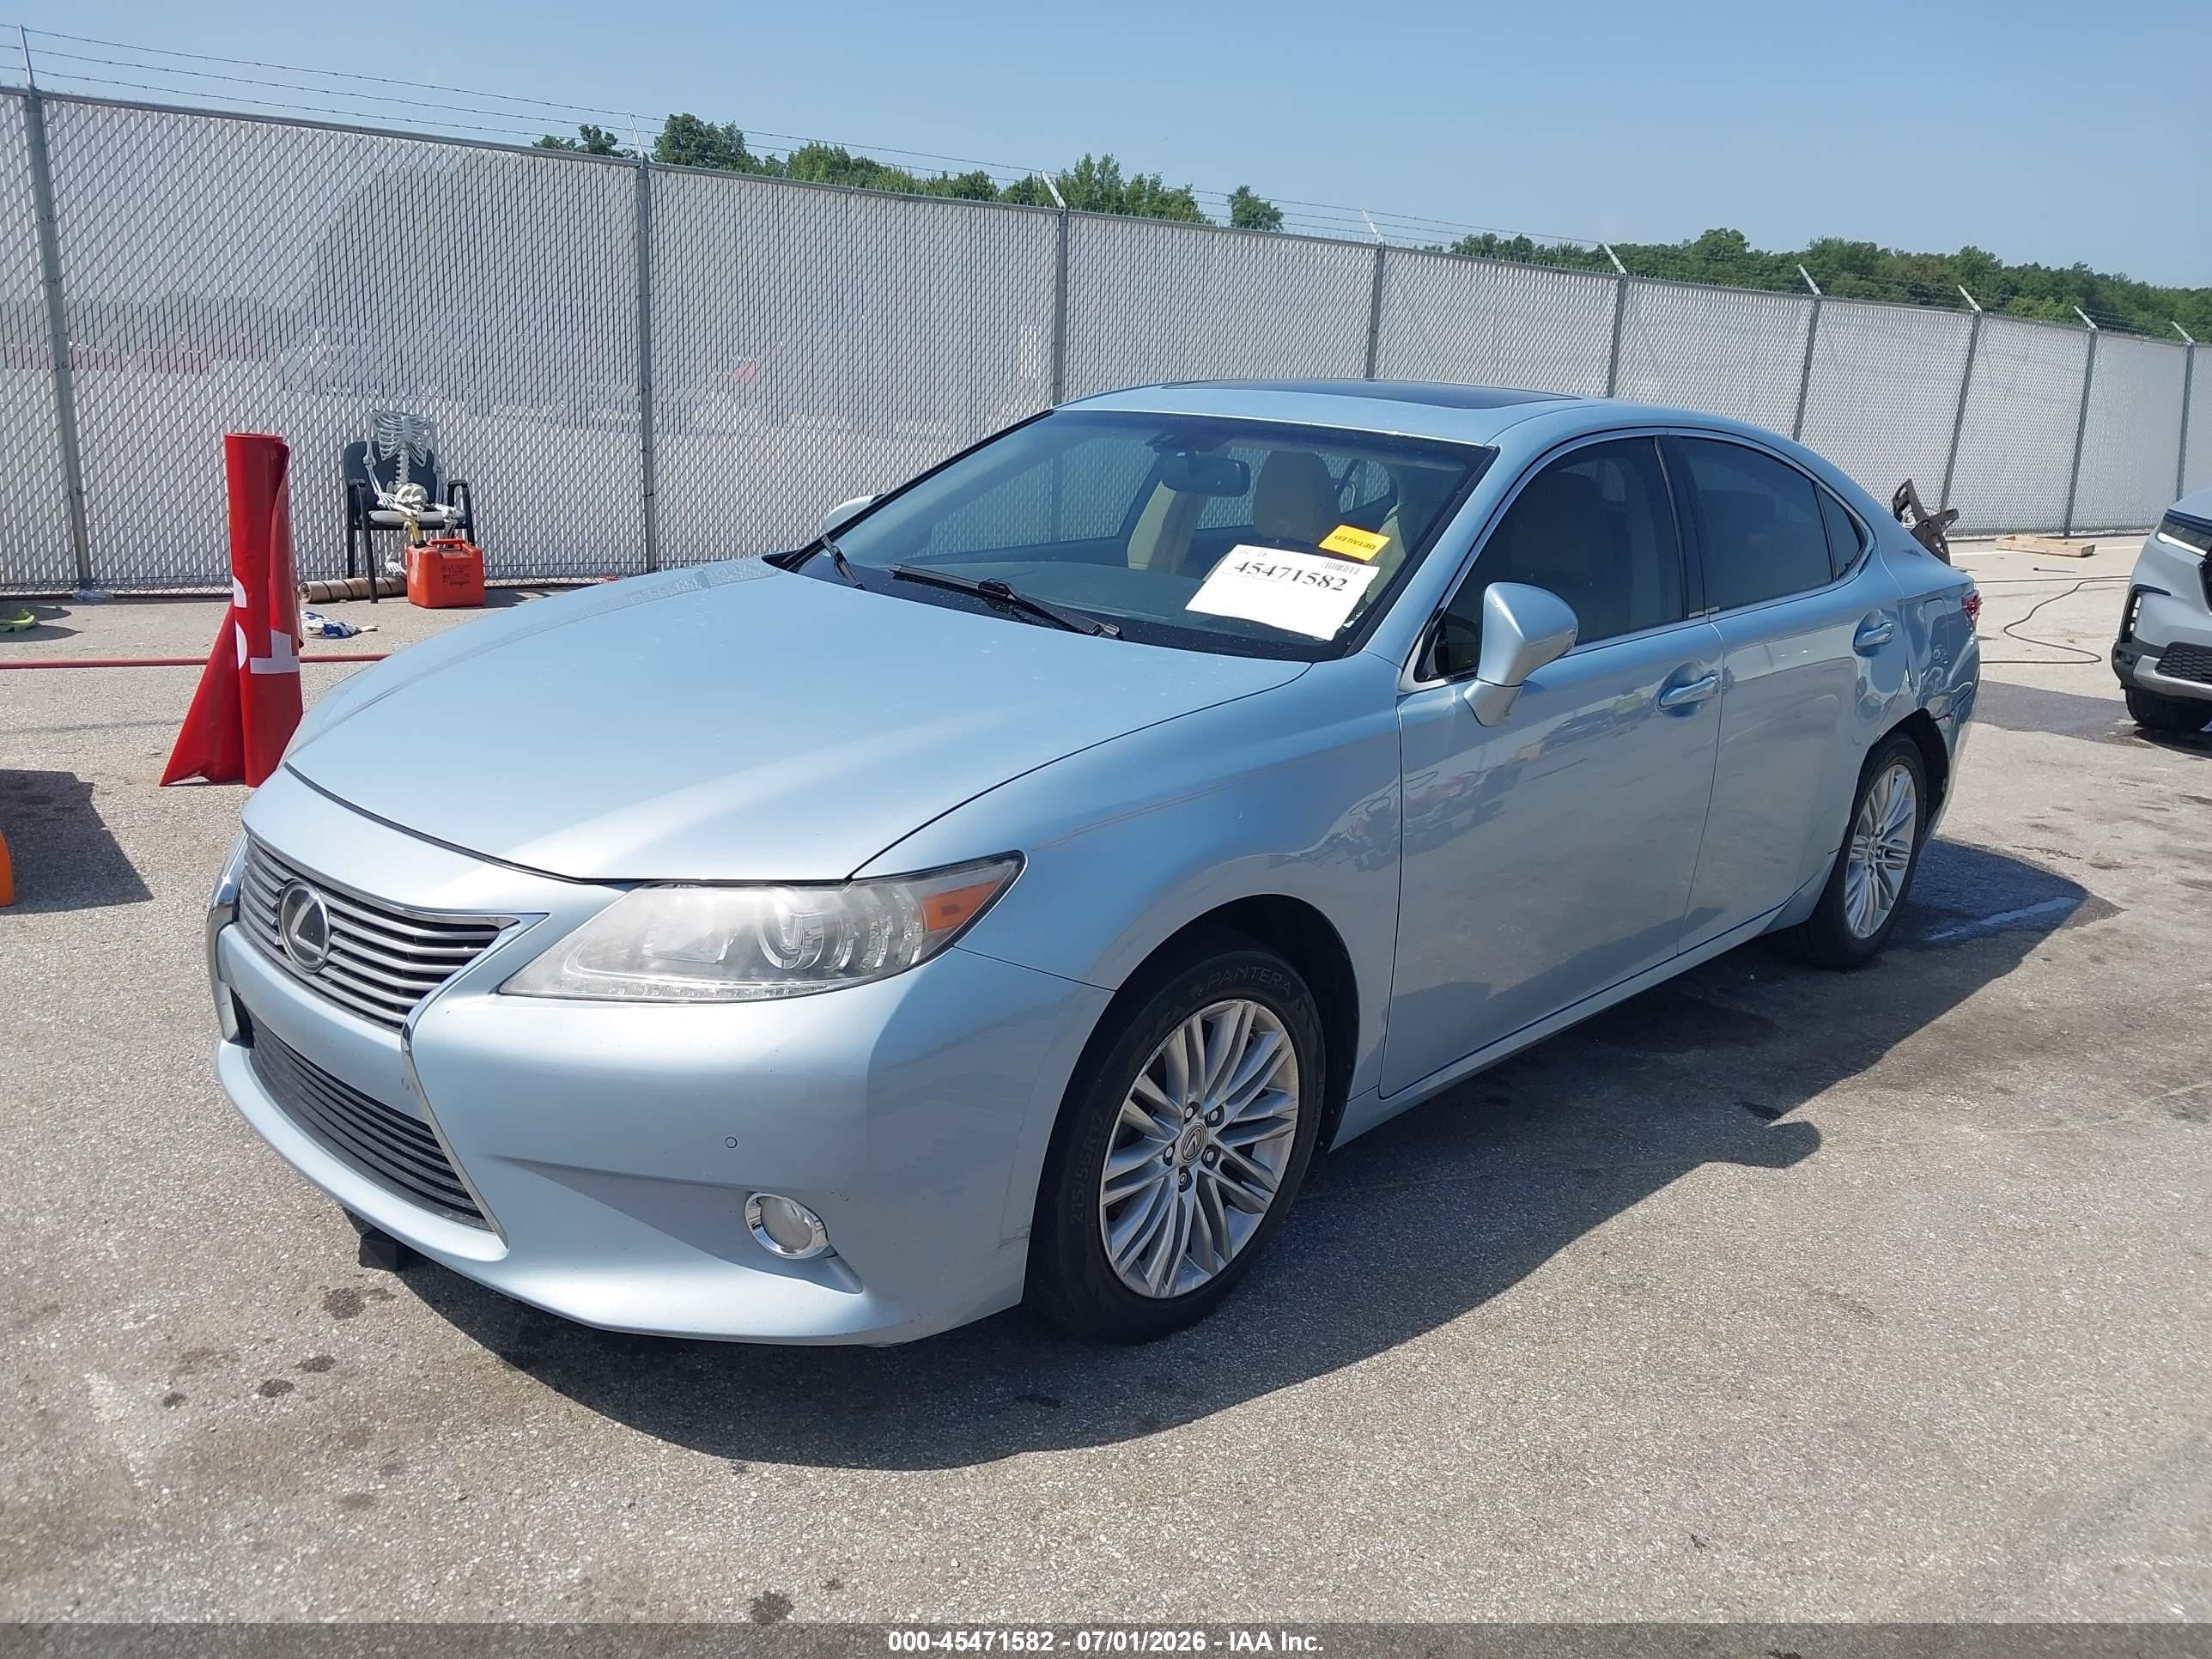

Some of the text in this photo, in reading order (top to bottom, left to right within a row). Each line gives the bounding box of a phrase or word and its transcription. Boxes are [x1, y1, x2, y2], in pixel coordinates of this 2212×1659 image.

[1334, 534, 1376, 550] DETAILED
[1233, 561, 1349, 592] 45471582
[1207, 963, 1291, 996] PANTERA
